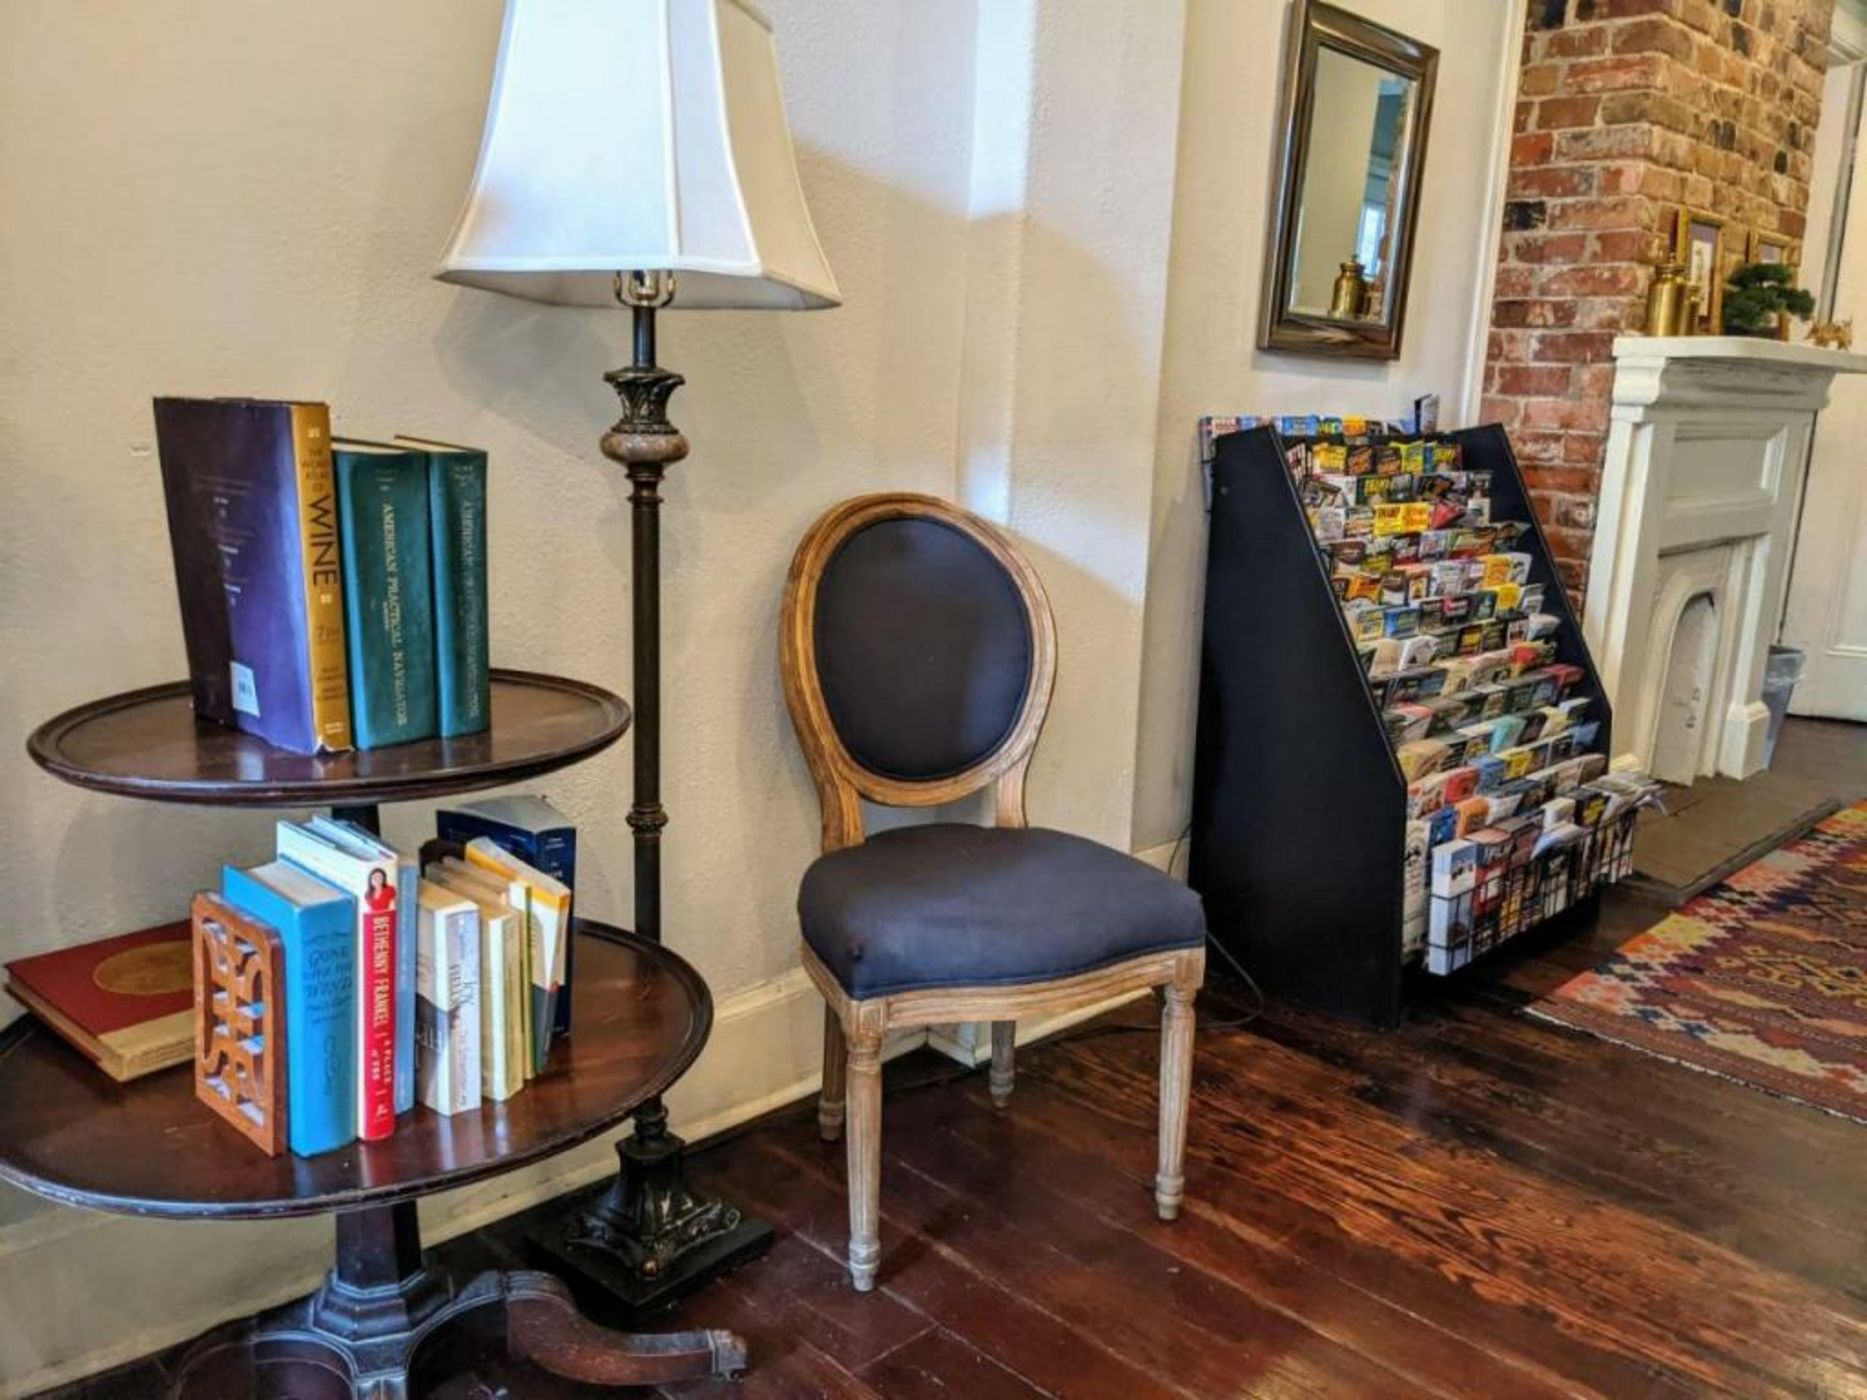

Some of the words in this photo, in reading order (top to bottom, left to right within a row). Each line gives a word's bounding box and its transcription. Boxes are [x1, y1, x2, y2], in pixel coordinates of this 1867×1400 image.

[308, 494, 339, 586] WINE
[382, 502, 398, 572] AMERICAN
[373, 916, 390, 974] BETHENNY
[373, 978, 390, 1028] FRANKEL
